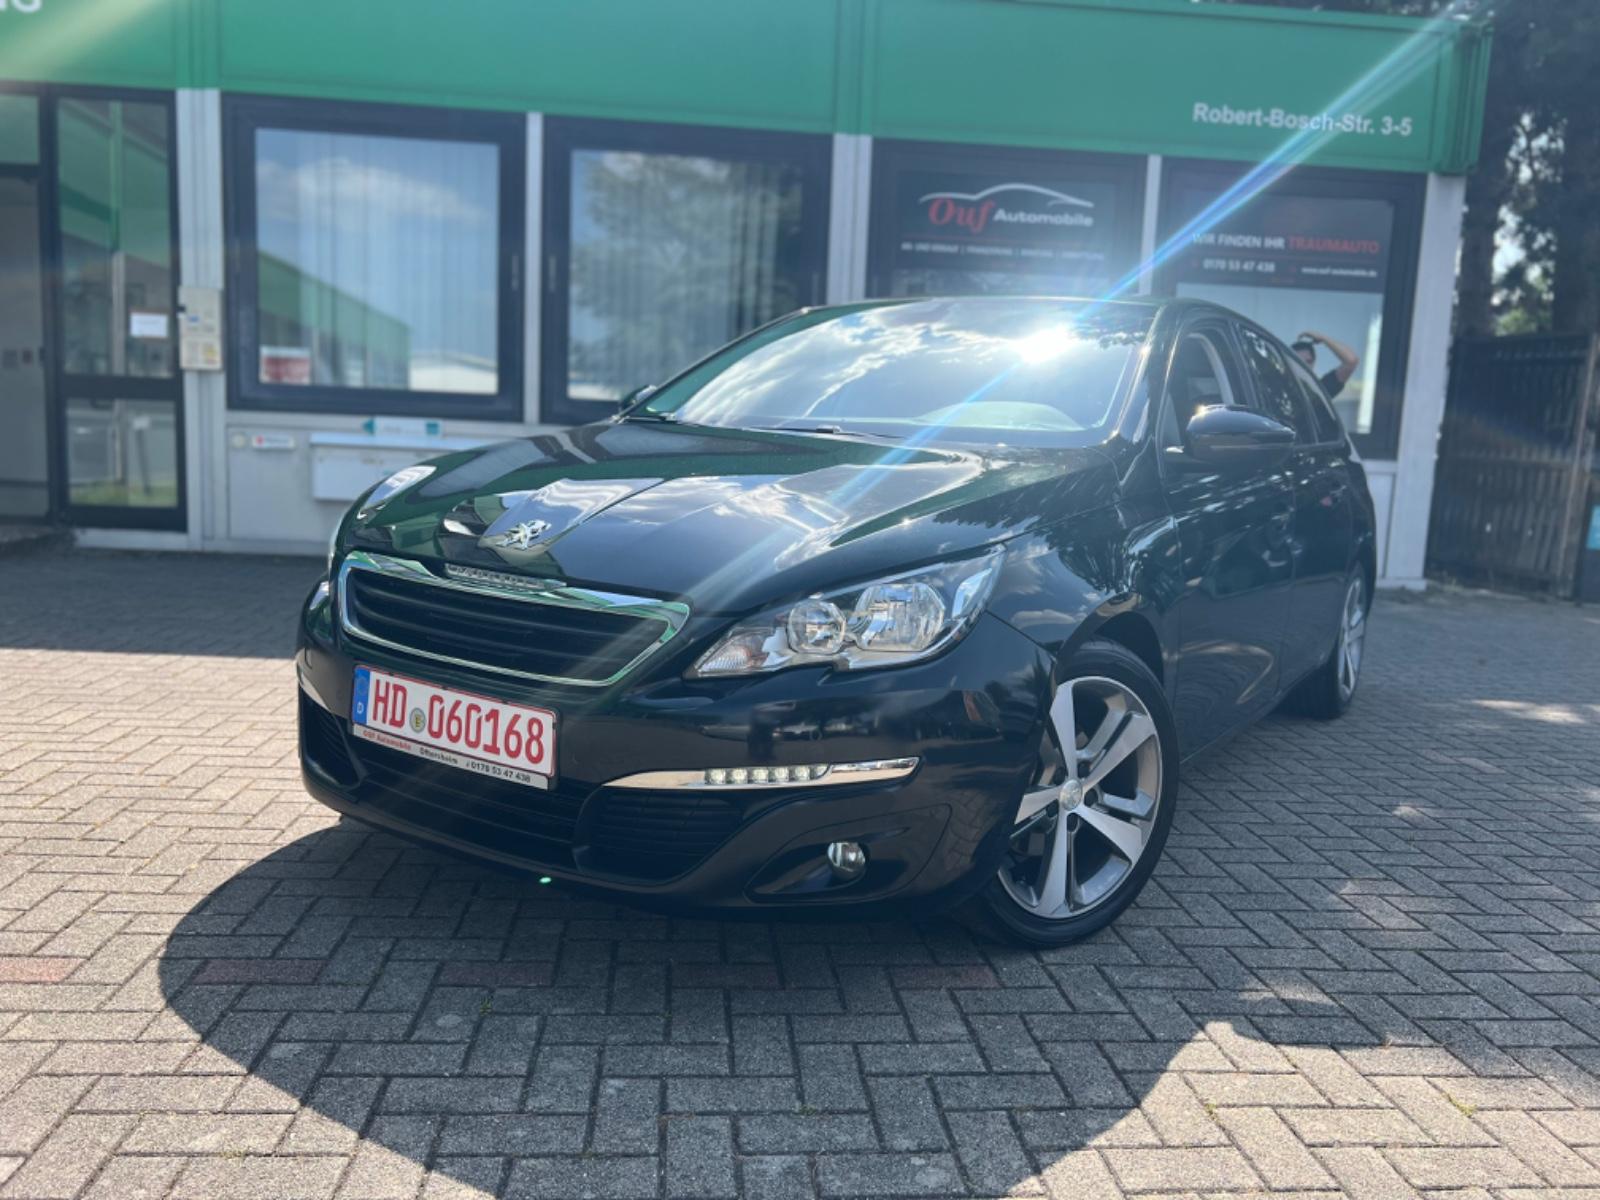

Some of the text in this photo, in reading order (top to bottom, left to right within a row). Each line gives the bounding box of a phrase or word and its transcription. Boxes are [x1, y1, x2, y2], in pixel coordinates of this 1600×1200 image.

[1192, 102, 1413, 137] Robert-Bosch-Str. 3-5
[928, 196, 1095, 235] Ouf Automobile
[1217, 234, 1262, 249] FINDEN
[1264, 236, 1286, 250] IHR
[1288, 235, 1380, 255] TRAUMAUTO
[372, 678, 545, 765] HD 060168
